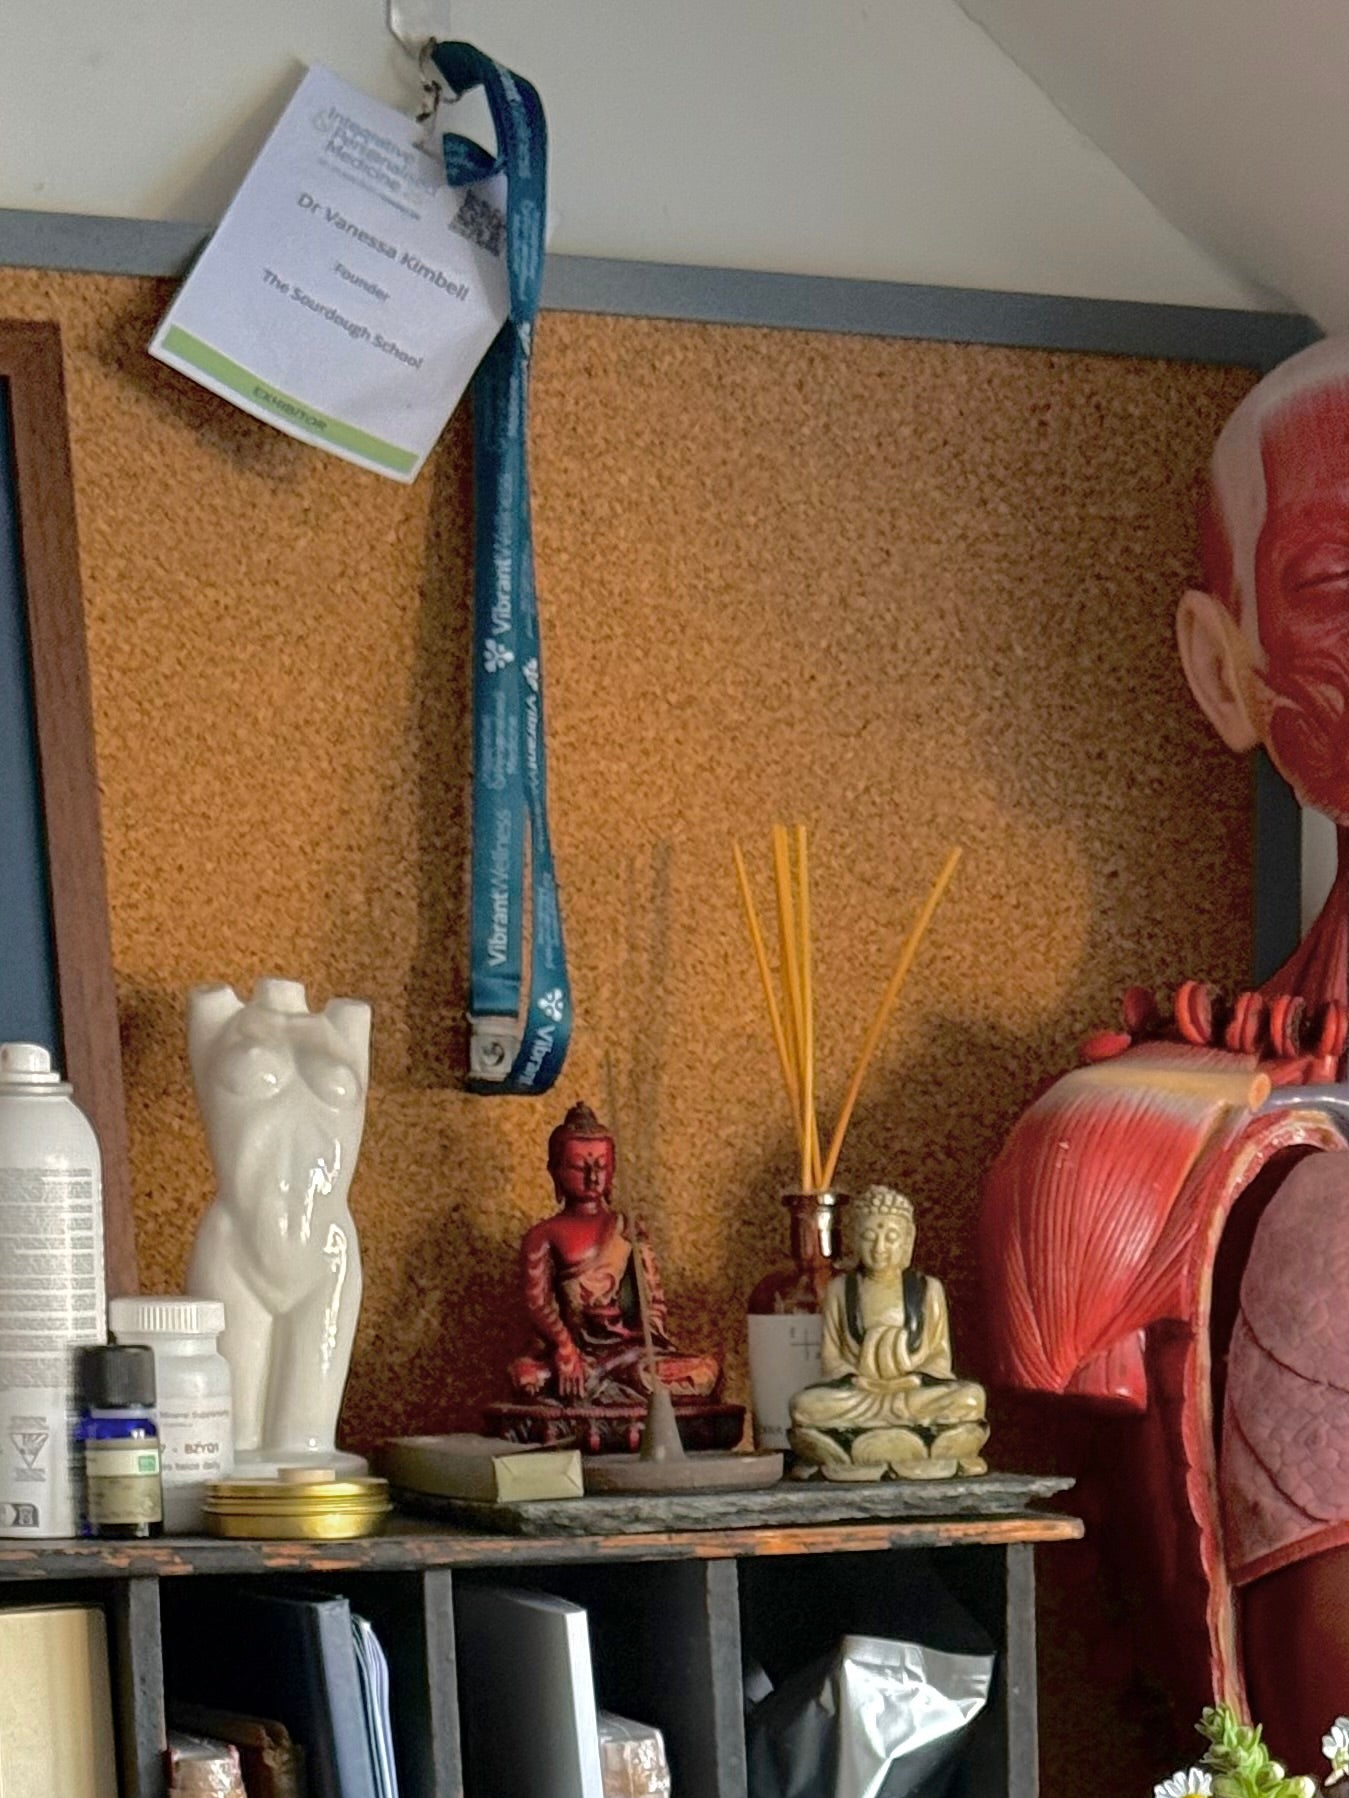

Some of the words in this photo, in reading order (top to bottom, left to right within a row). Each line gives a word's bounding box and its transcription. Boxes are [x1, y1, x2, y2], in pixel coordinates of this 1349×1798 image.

[297, 192, 323, 214] Dr
[323, 207, 397, 260] Vanessa
[400, 252, 471, 302] Kimbell
[334, 262, 391, 301] Founder
[262, 268, 290, 294] The
[291, 286, 371, 342] Sourdough
[372, 333, 424, 370] School
[252, 385, 328, 431] EXHIBITOR
